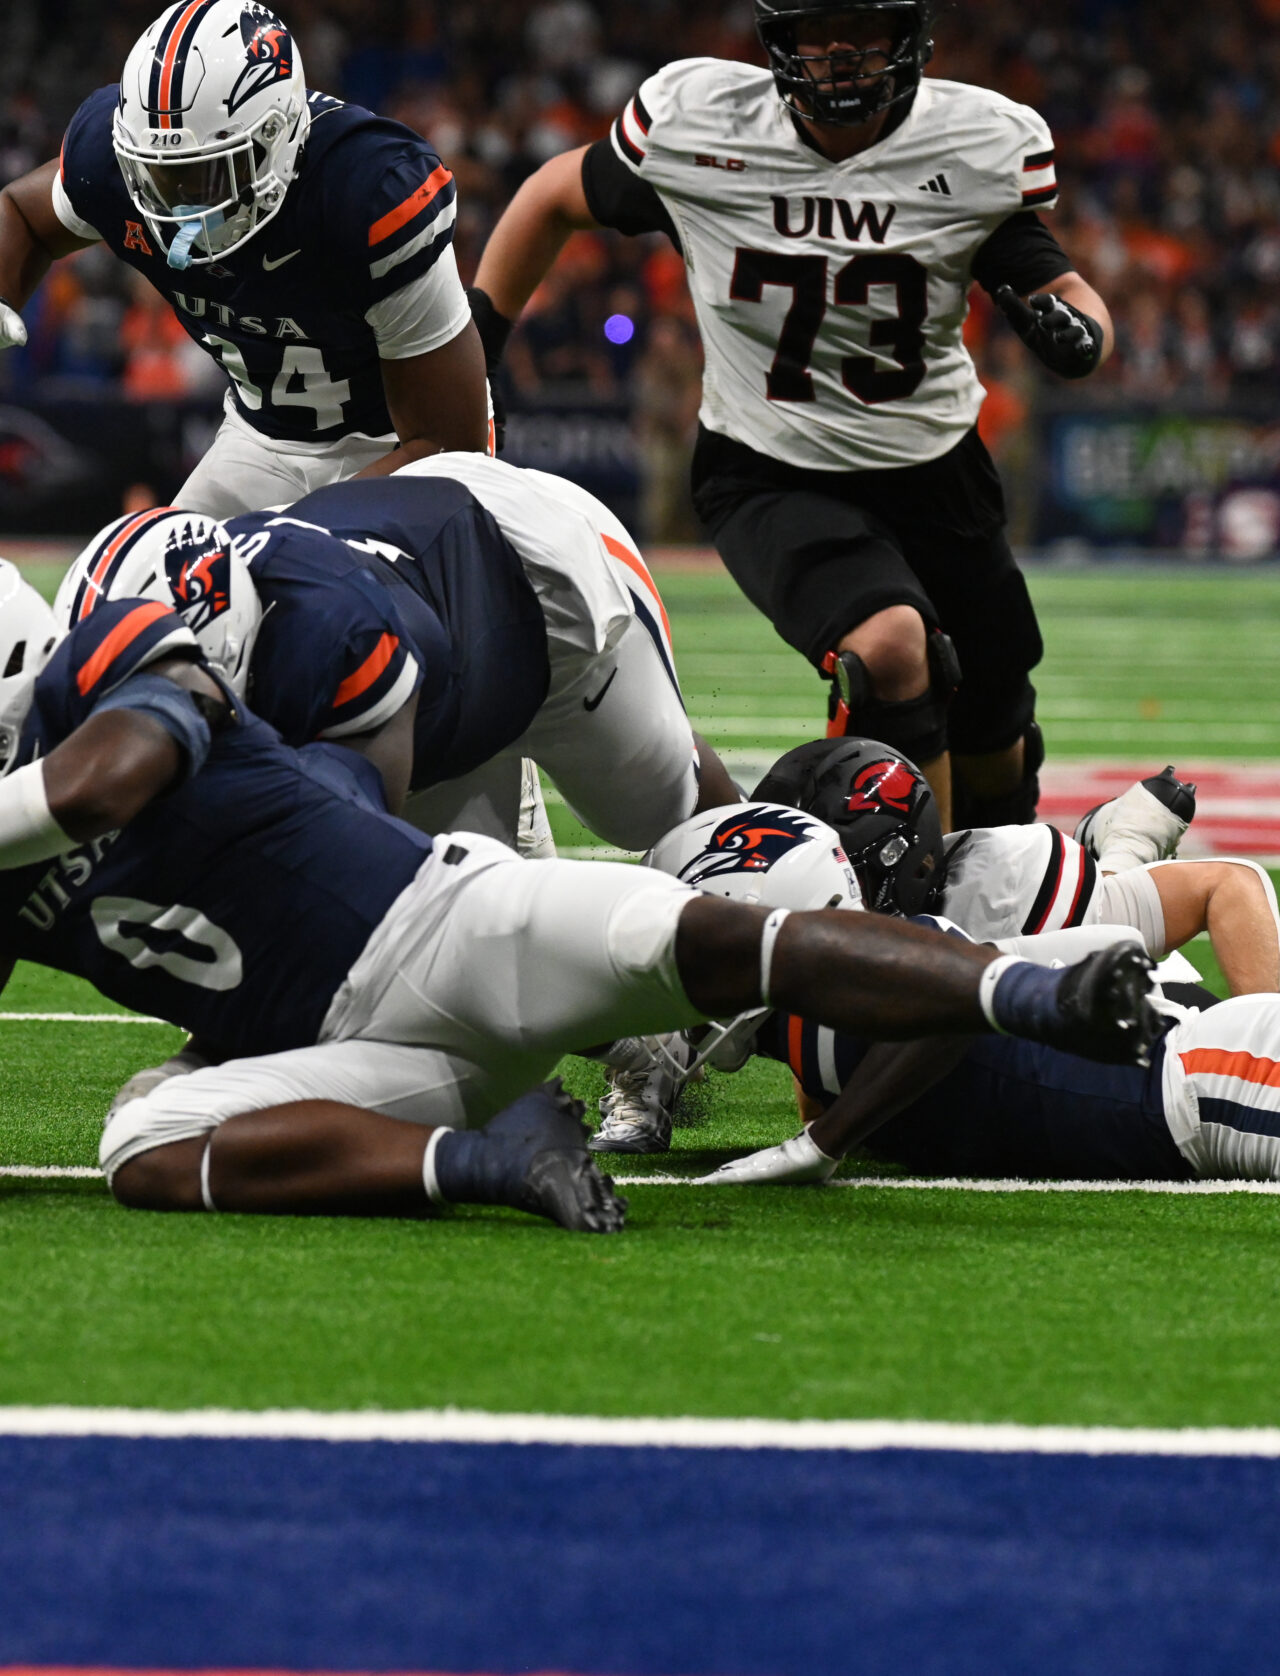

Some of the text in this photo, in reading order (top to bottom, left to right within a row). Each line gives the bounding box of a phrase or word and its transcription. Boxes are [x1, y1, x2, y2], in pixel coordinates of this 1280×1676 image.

[150, 133, 181, 146] 210
[770, 195, 896, 244] UIW
[172, 290, 309, 340] UTSA
[729, 247, 928, 405] 73
[90, 896, 243, 991] 0
